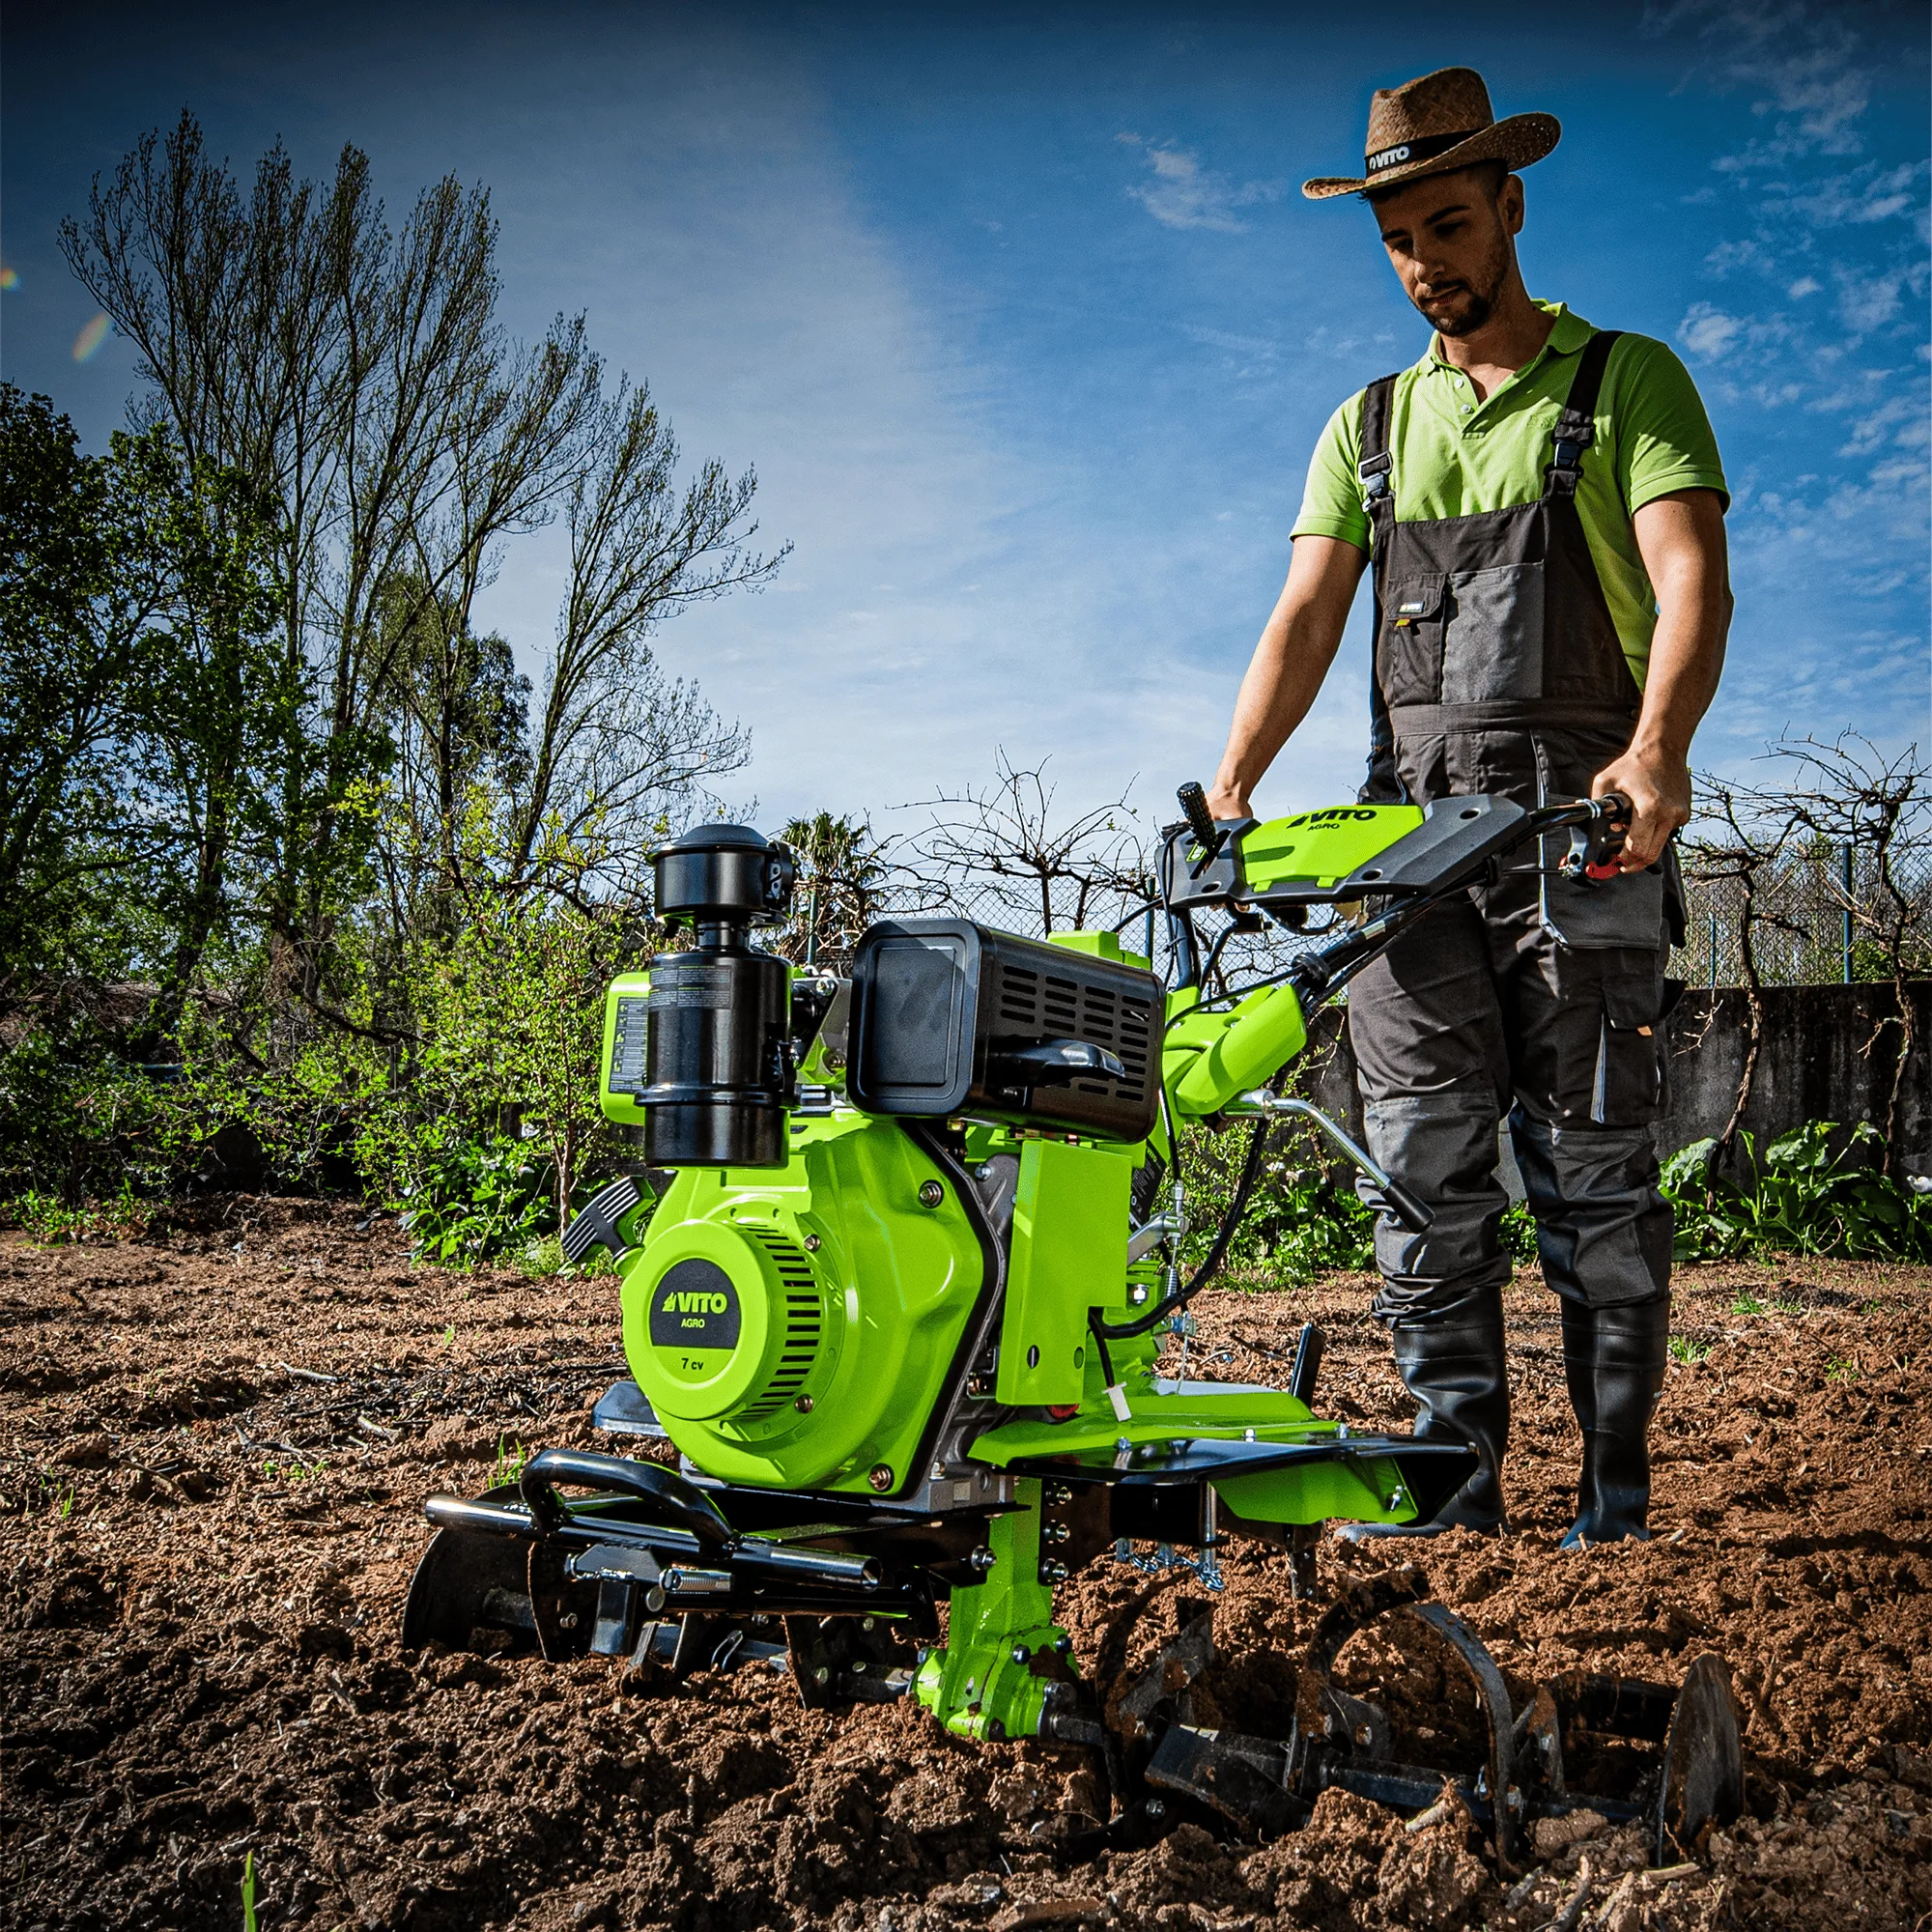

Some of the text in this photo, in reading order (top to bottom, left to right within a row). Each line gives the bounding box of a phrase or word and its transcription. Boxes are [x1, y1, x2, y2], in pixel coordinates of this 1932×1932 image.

[1376, 146, 1409, 168] VITO
[1310, 809, 1377, 823] VITO
[1307, 822, 1340, 832] AGRO
[677, 1292, 727, 1314] VITO
[680, 1318, 705, 1328] AGRO
[681, 1357, 689, 1370] 7
